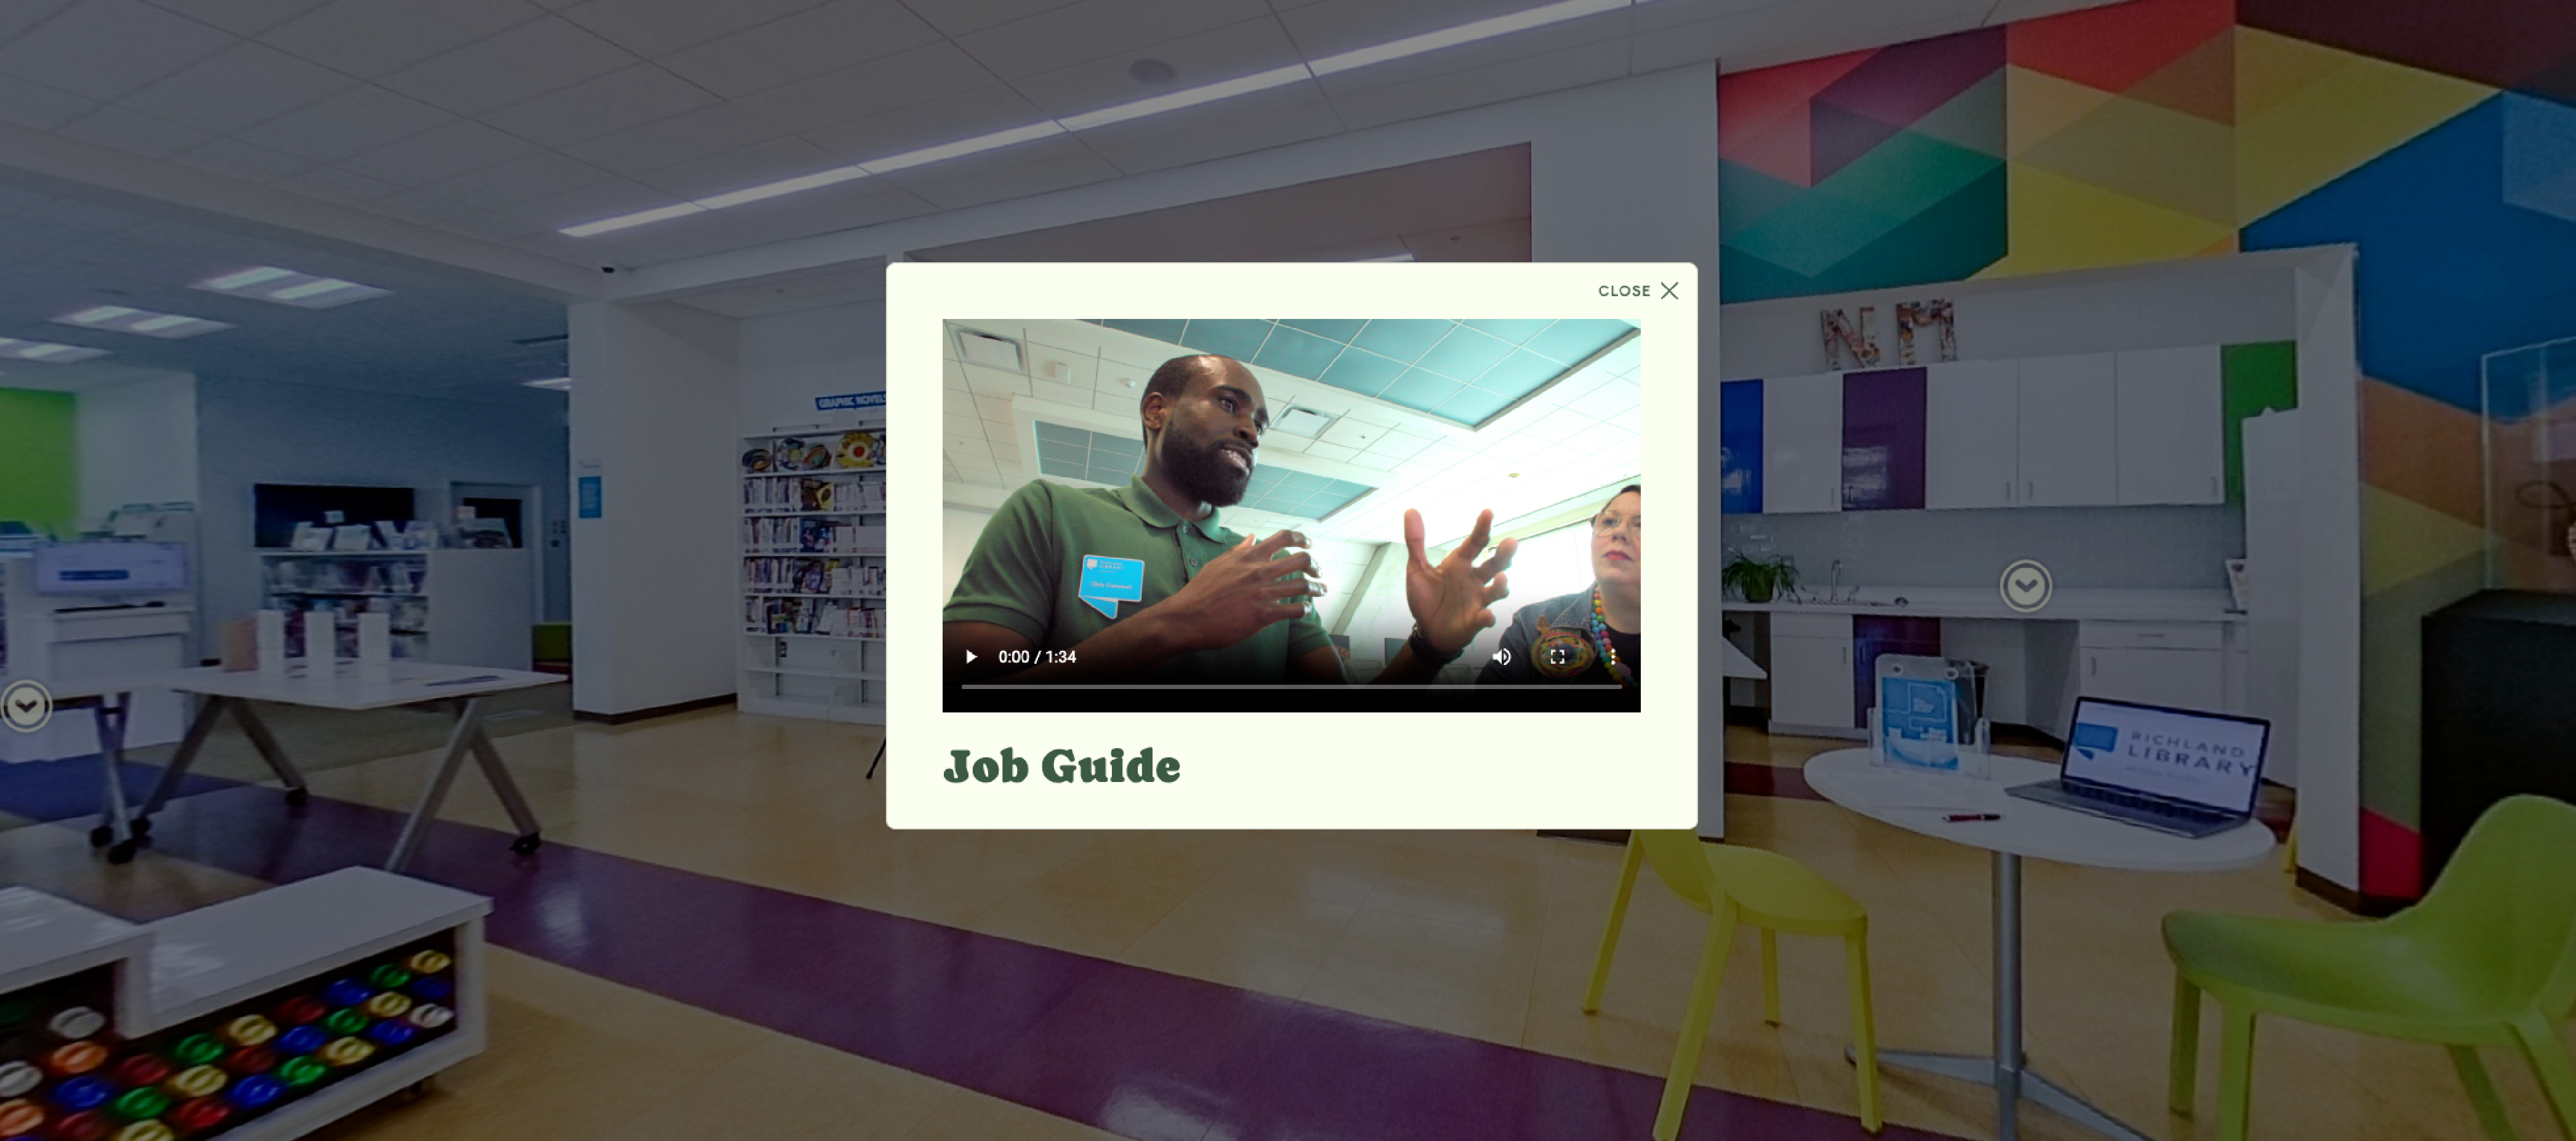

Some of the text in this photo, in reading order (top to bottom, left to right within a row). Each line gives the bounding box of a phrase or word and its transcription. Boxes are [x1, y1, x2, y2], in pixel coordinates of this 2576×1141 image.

[818, 397, 854, 408] GRAPHIC
[2130, 730, 2245, 757] RICHLAND
[2127, 744, 2256, 776] LIBRARY
